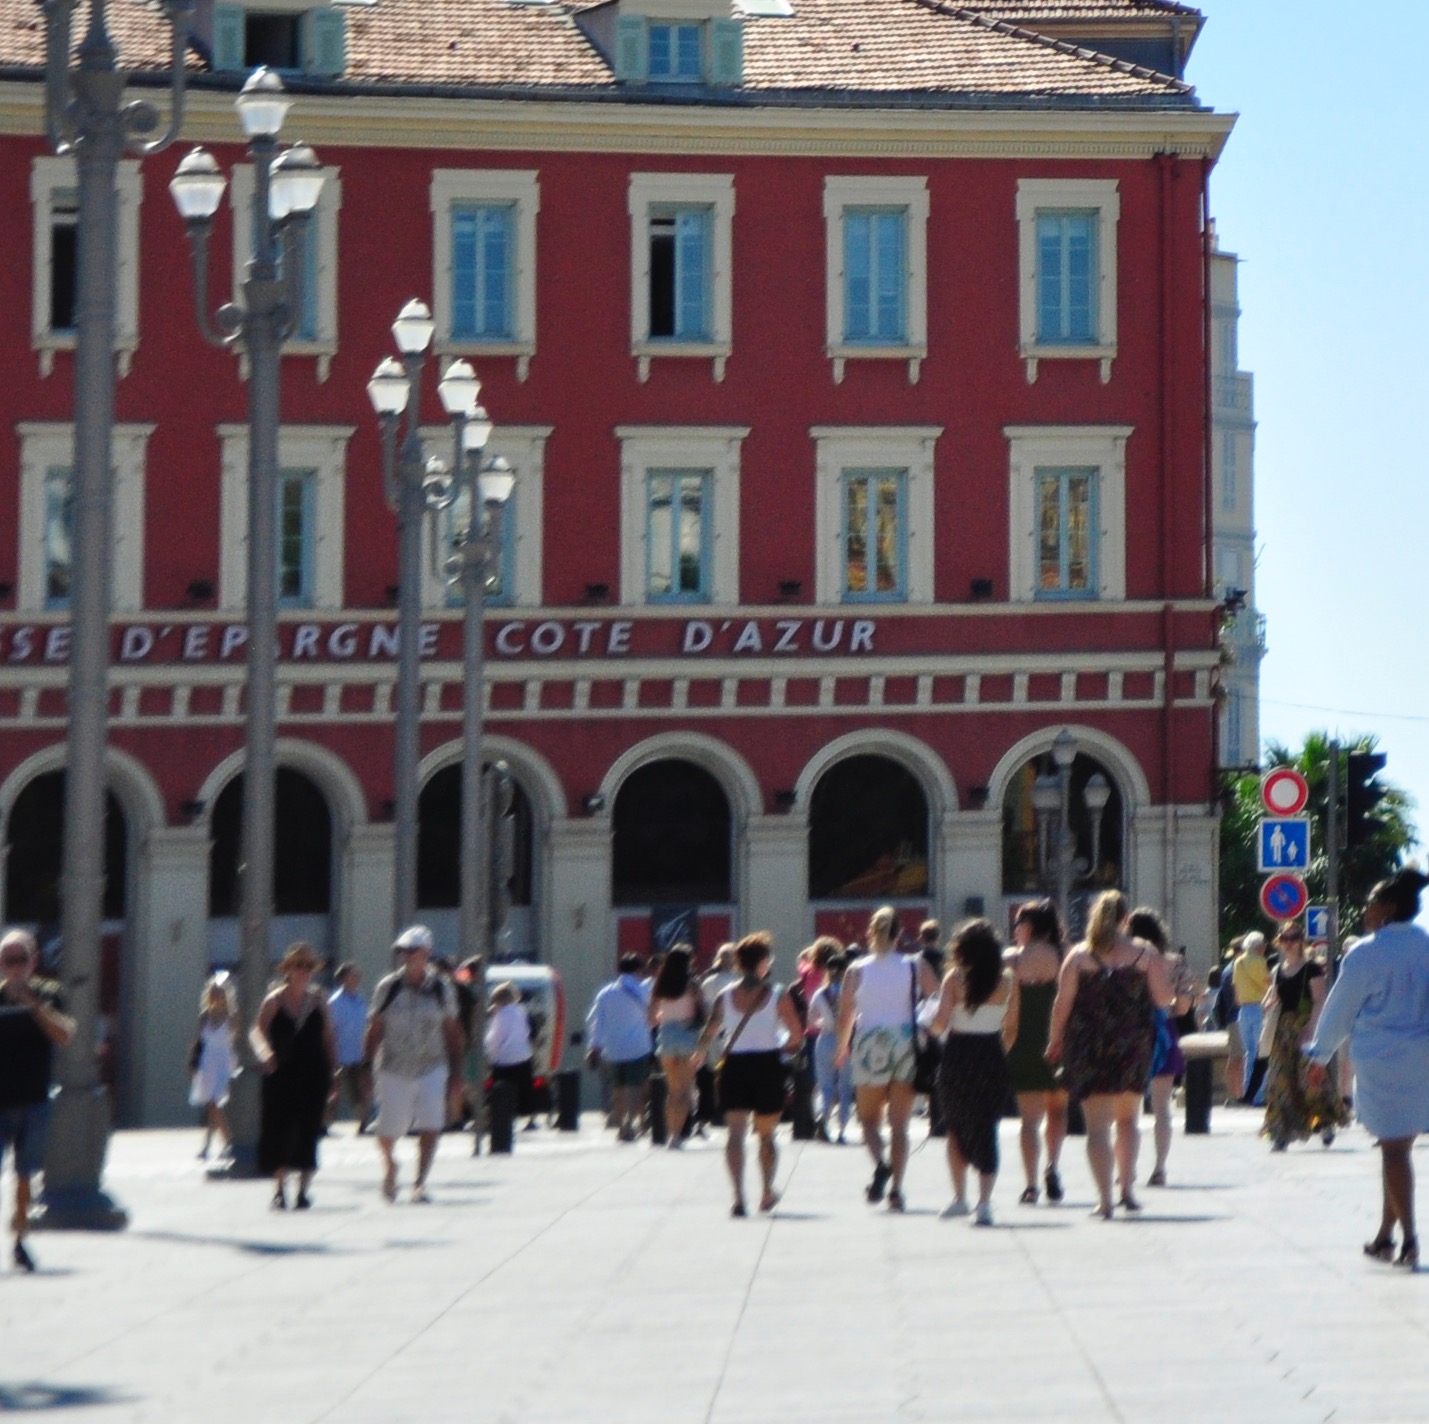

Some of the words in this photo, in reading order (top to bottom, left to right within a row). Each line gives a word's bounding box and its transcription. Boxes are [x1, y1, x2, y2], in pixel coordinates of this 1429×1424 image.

[0, 626, 71, 660] SE
[120, 623, 439, 660] D'EPRGNE
[495, 621, 633, 655] COTE
[682, 619, 876, 652] D'AZUR
